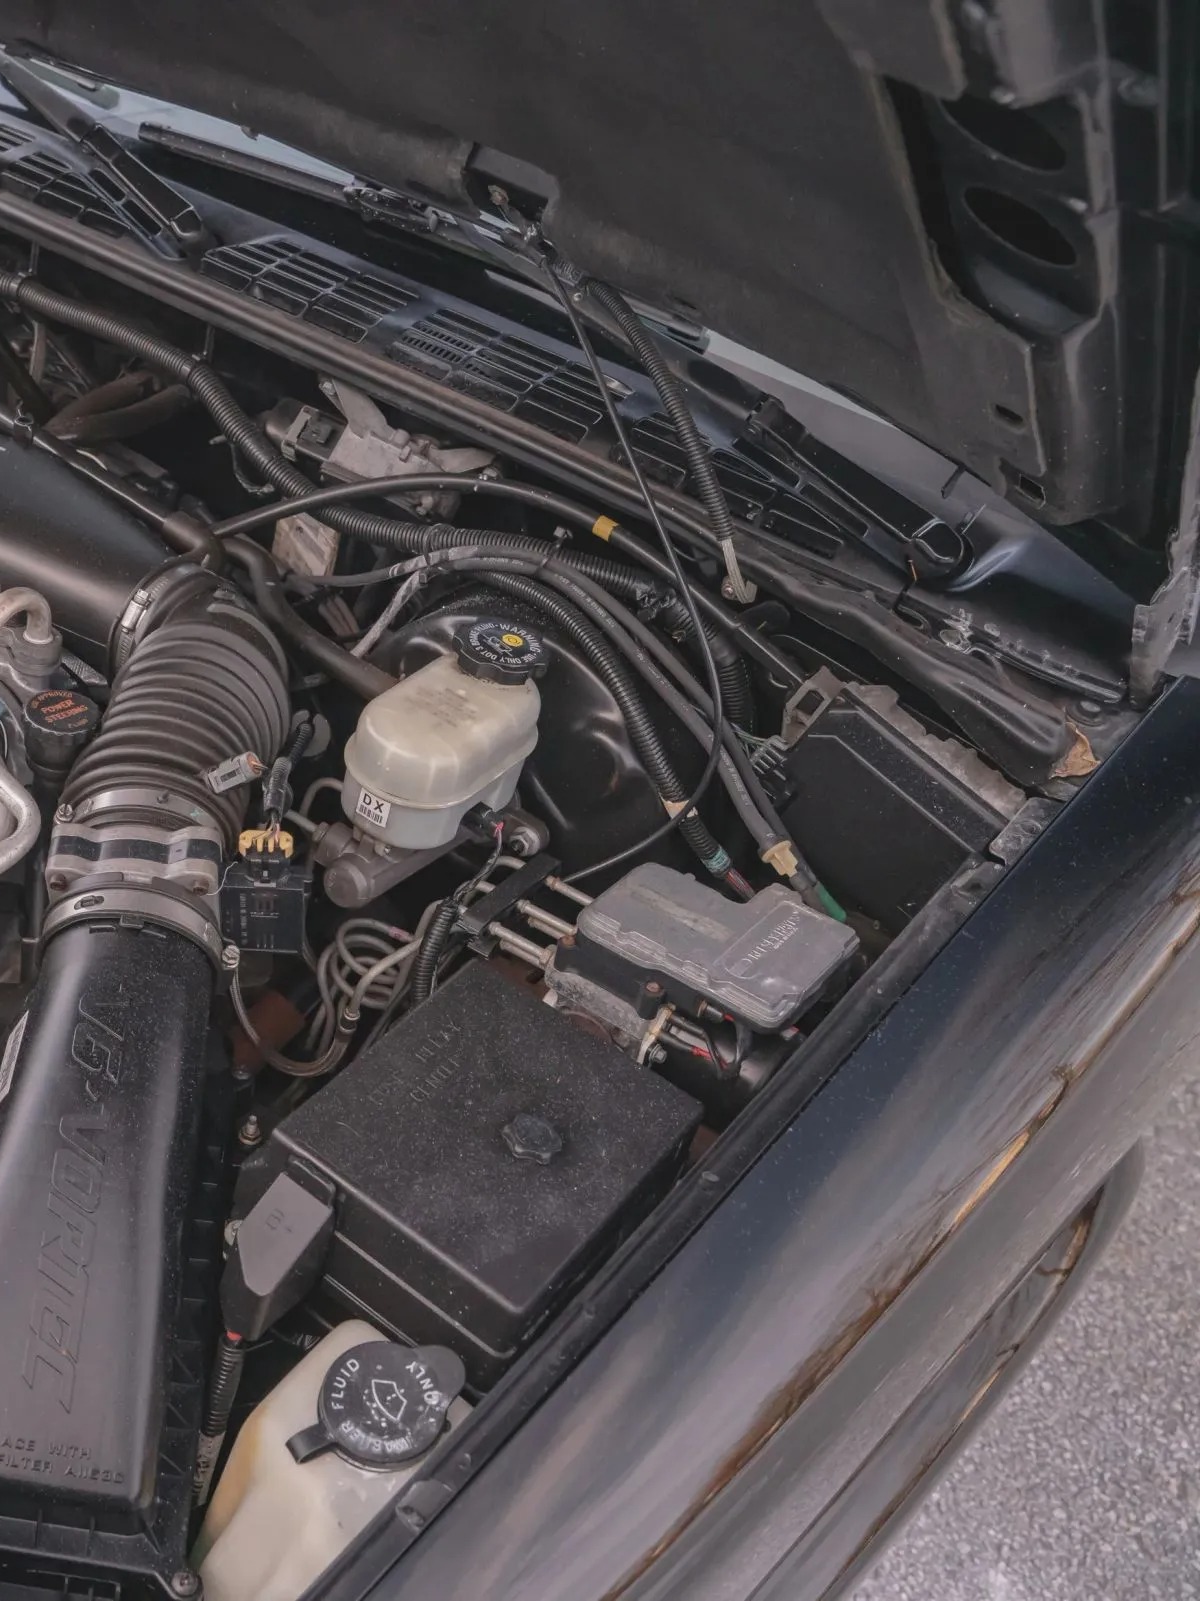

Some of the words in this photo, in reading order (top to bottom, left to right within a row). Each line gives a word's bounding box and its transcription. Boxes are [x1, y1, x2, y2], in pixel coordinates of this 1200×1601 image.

[499, 623, 541, 653] WARNING
[480, 649, 497, 660] DOT
[40, 698, 74, 714] POWER
[44, 703, 88, 723] STEERING
[361, 792, 384, 813] DX
[330, 1357, 360, 1410] FLUID
[405, 1360, 440, 1405] ONLY
[48, 1440, 92, 1460] WITH
